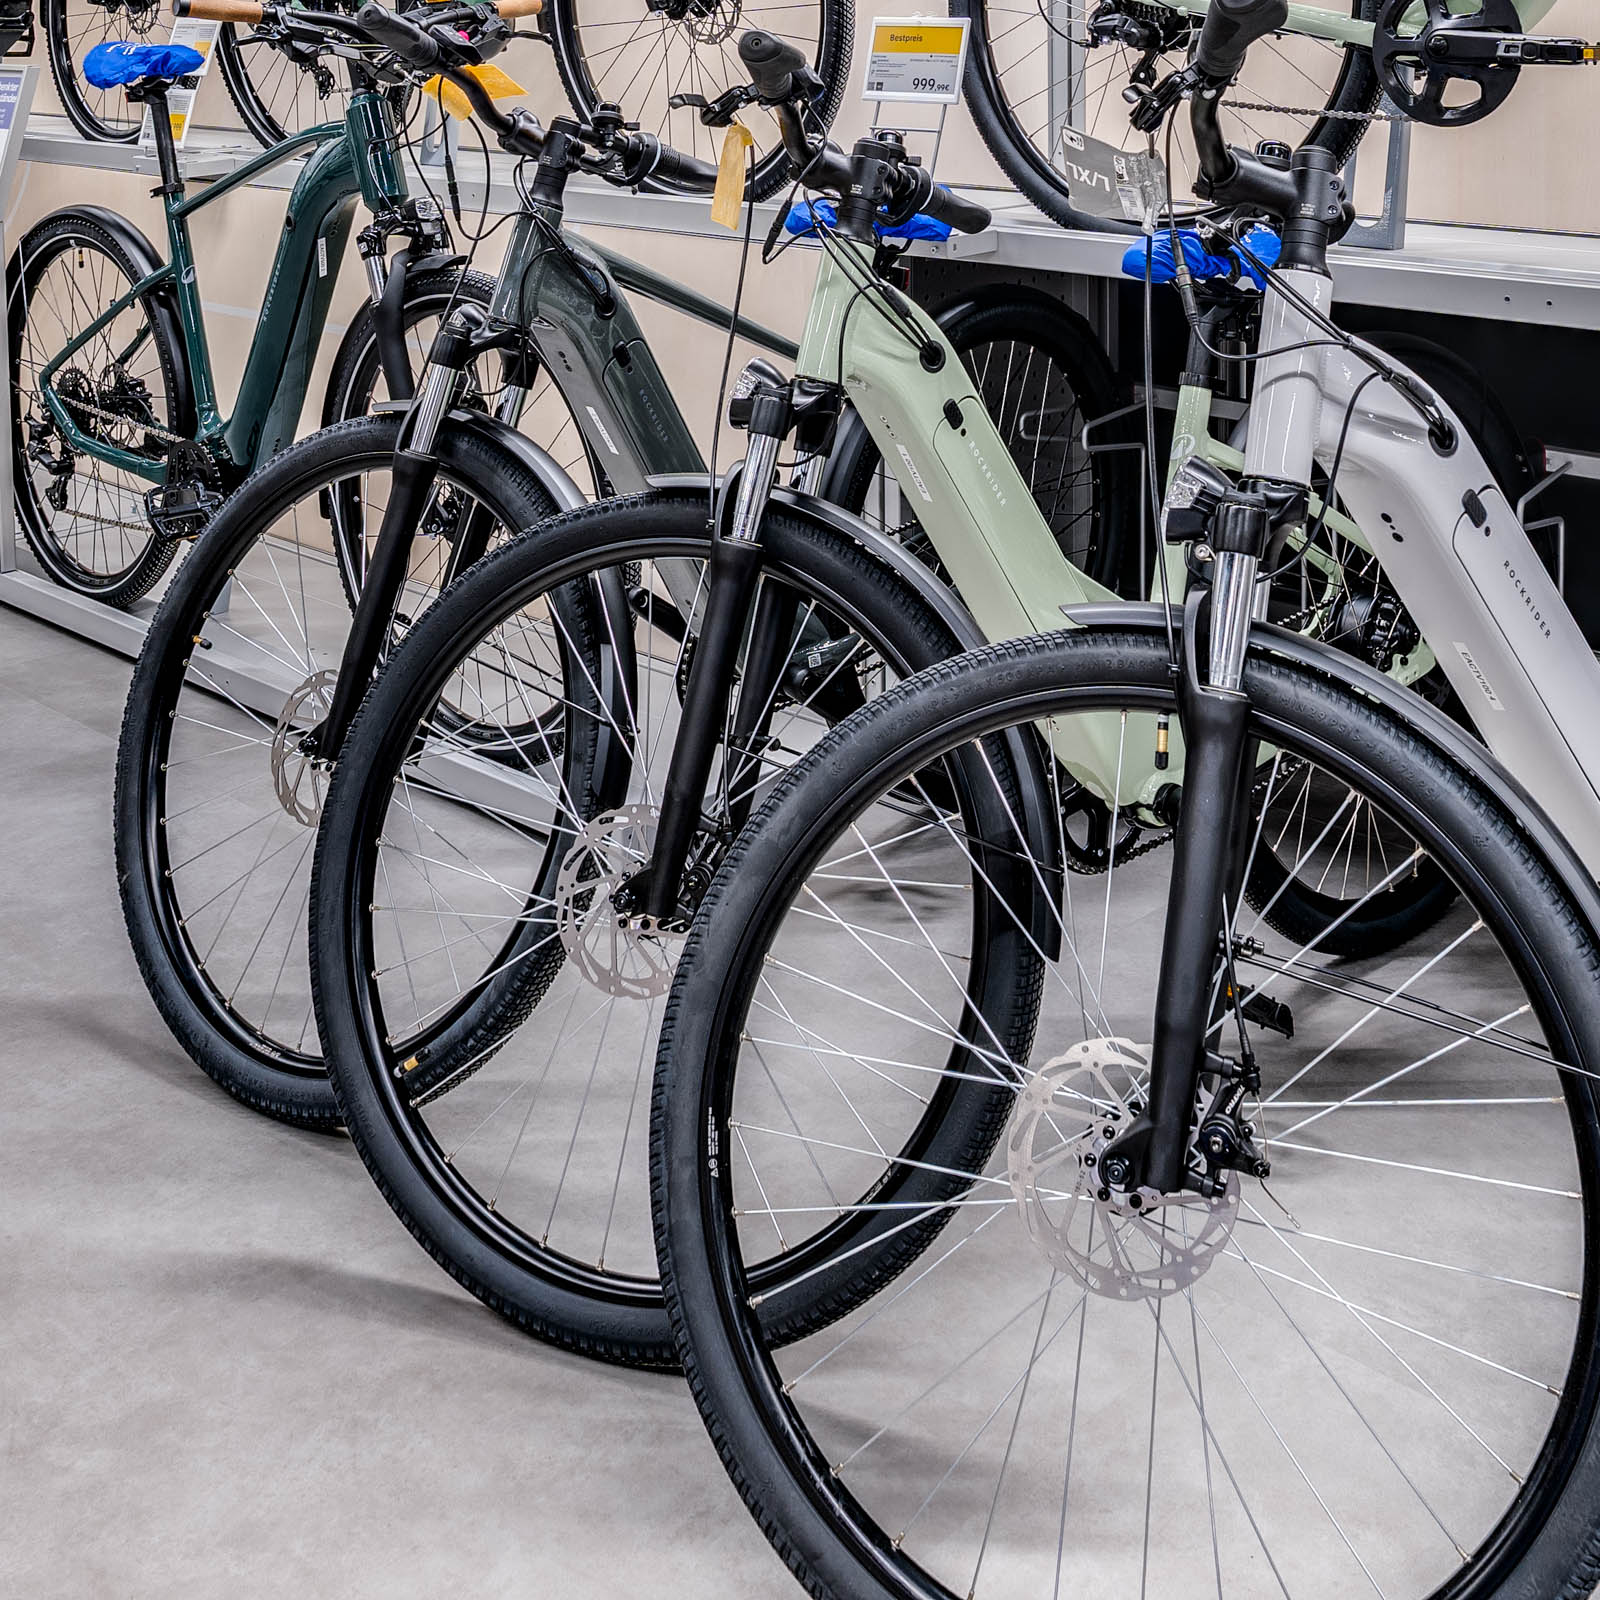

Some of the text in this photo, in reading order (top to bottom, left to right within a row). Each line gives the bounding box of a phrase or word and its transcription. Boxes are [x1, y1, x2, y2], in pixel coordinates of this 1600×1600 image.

[890, 34, 923, 43] Bestpreis
[968, 440, 1007, 507] ROCKRIDER
[1503, 560, 1551, 638] ROCKRIDER
[1461, 651, 1492, 696] EACTV100
